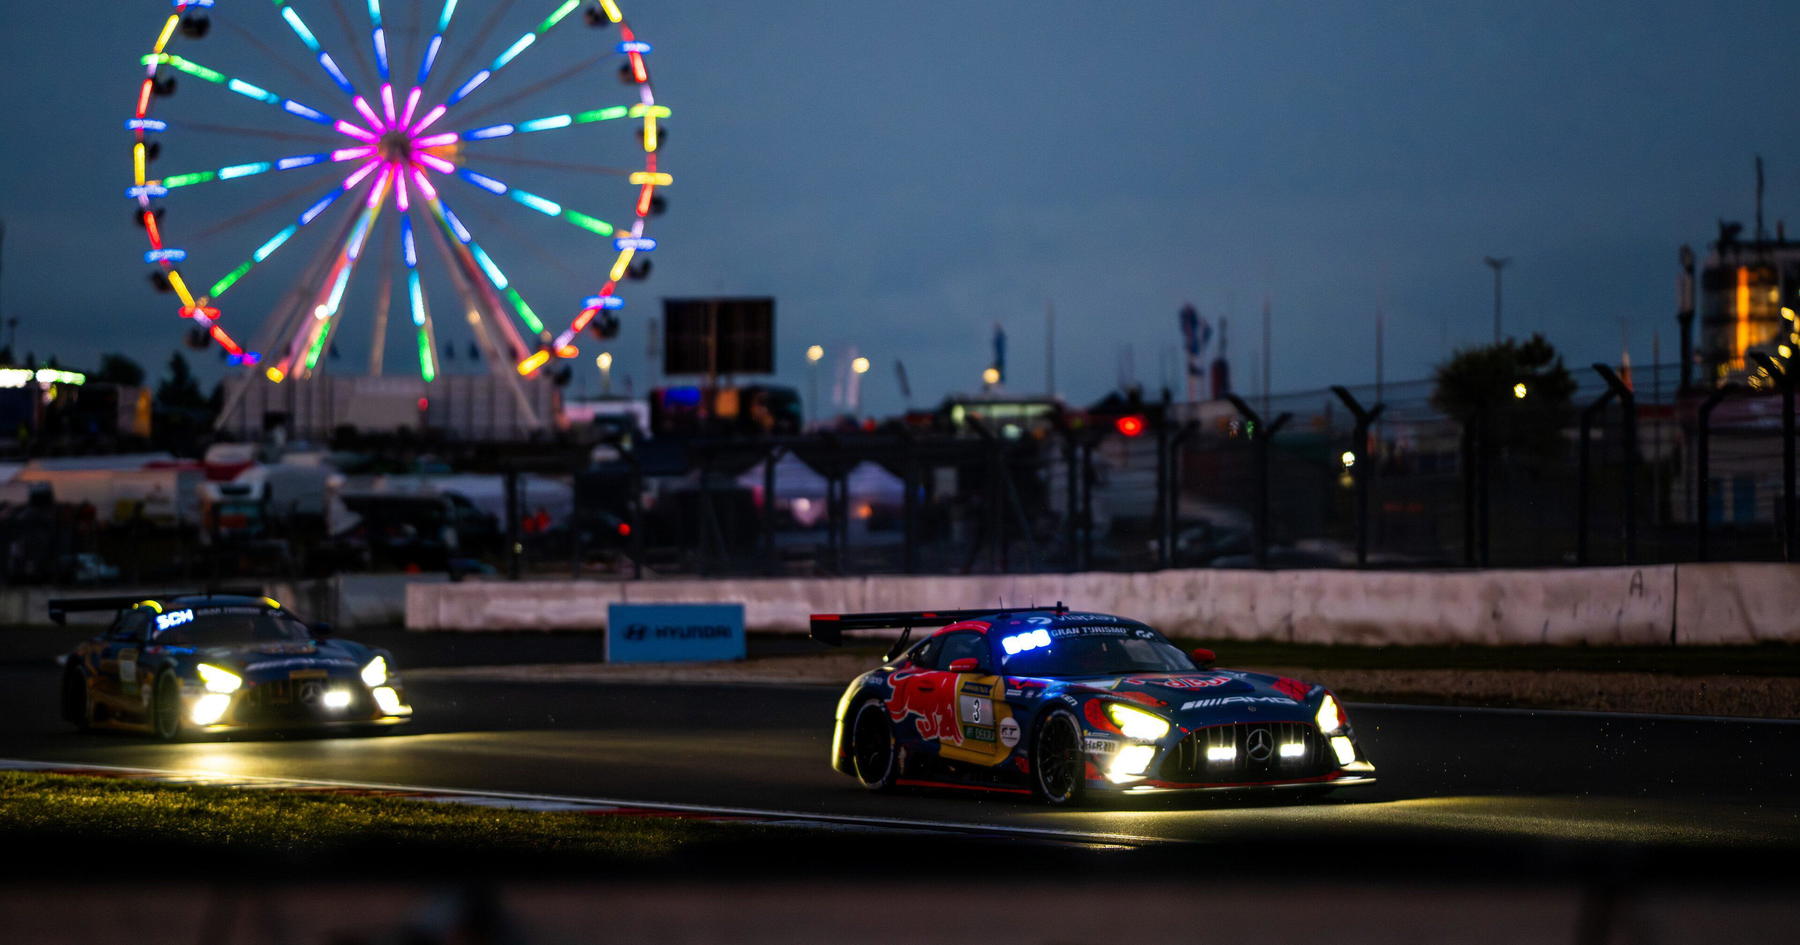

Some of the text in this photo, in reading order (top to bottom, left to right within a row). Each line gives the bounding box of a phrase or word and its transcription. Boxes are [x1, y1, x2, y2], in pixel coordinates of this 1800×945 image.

[155, 608, 194, 631] SCH
[656, 625, 732, 638] HYUNDAI
[1051, 626, 1080, 637] GRAN
[1081, 625, 1127, 635] TURISMO
[1221, 696, 1299, 705] AMG
[973, 699, 981, 722] 3
